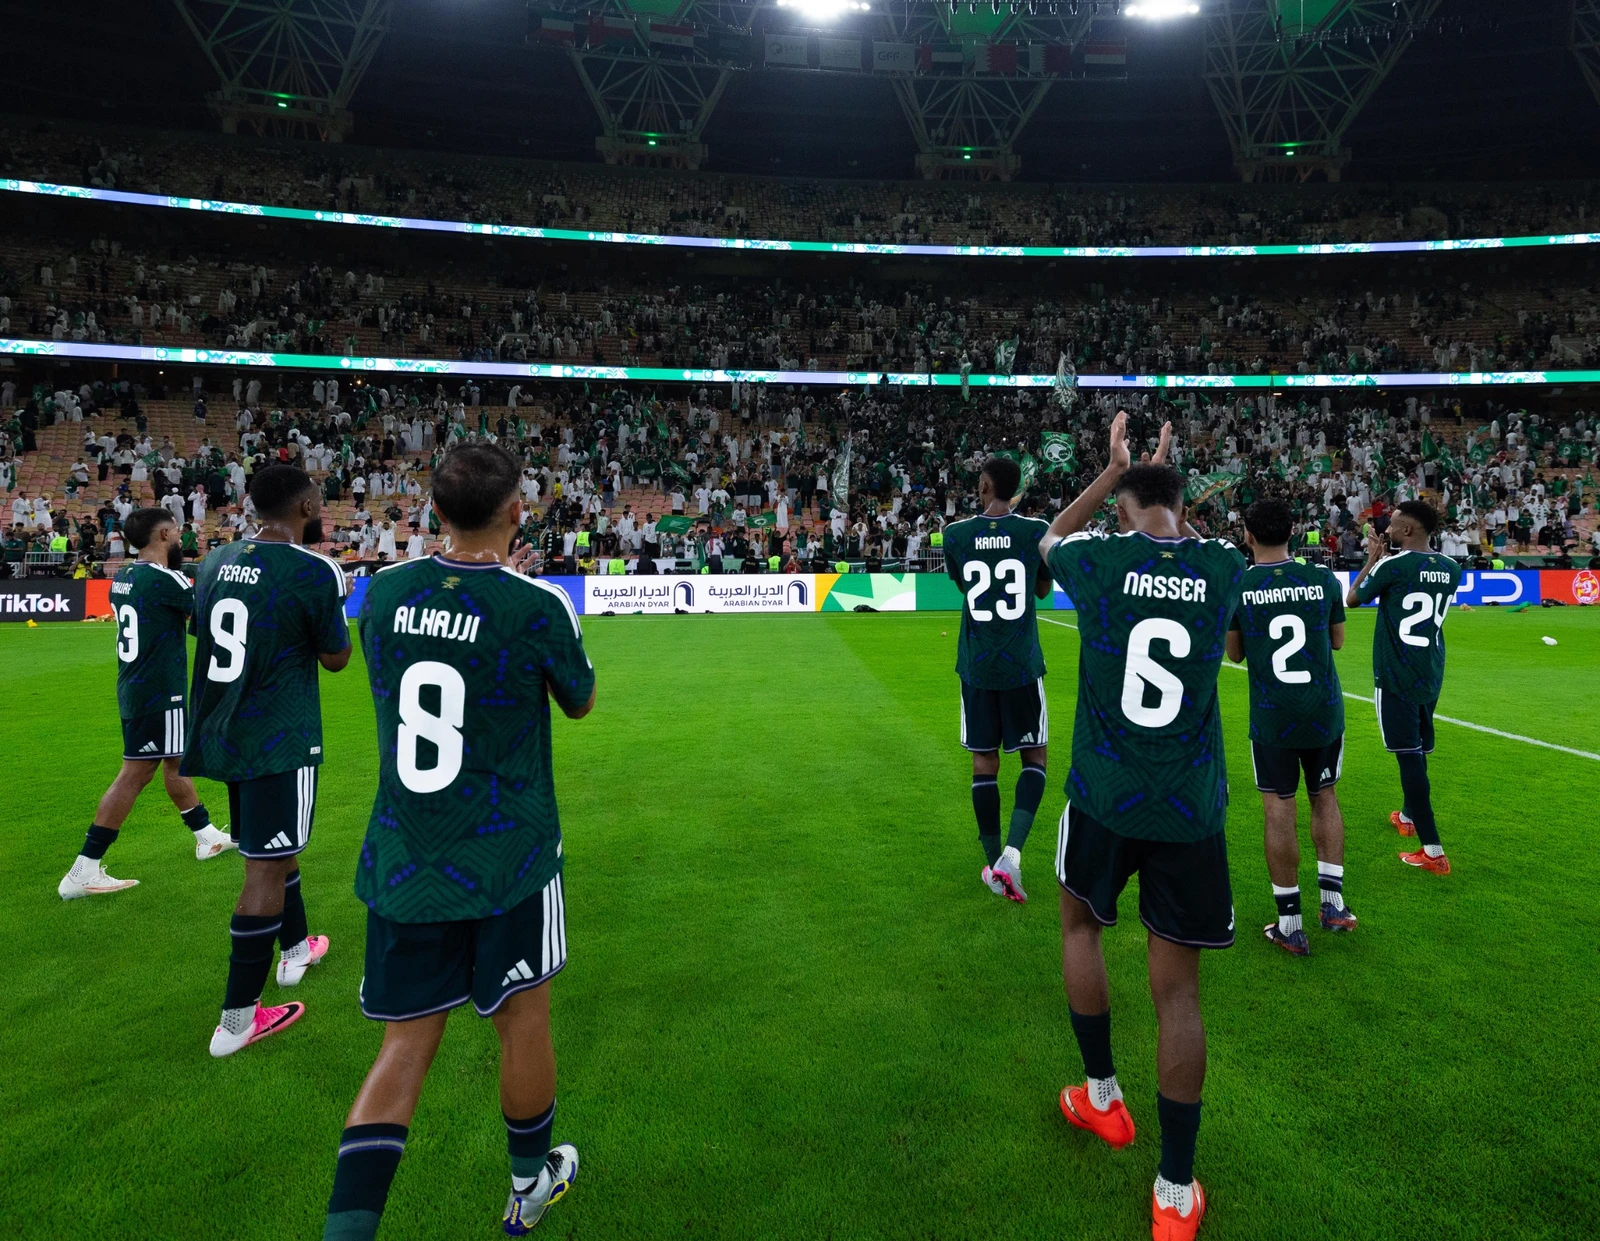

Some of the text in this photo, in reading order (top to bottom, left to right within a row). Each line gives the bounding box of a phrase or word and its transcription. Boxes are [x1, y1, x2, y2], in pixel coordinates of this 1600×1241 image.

[975, 536, 1011, 550] KANNO
[217, 565, 261, 584] FERAS
[963, 559, 1026, 621] 23
[1123, 572, 1207, 603] NASSER
[1420, 571, 1450, 584] MOTEB
[593, 586, 669, 600] الديار العربية
[708, 585, 783, 599] الديار العربية
[1243, 586, 1324, 606] MOHAMMED
[394, 606, 480, 643] ALHAJJI
[1399, 592, 1453, 647] 24
[207, 598, 249, 682] 9
[1269, 614, 1312, 683] 2
[1121, 618, 1191, 728] 6
[397, 661, 465, 793] 8
